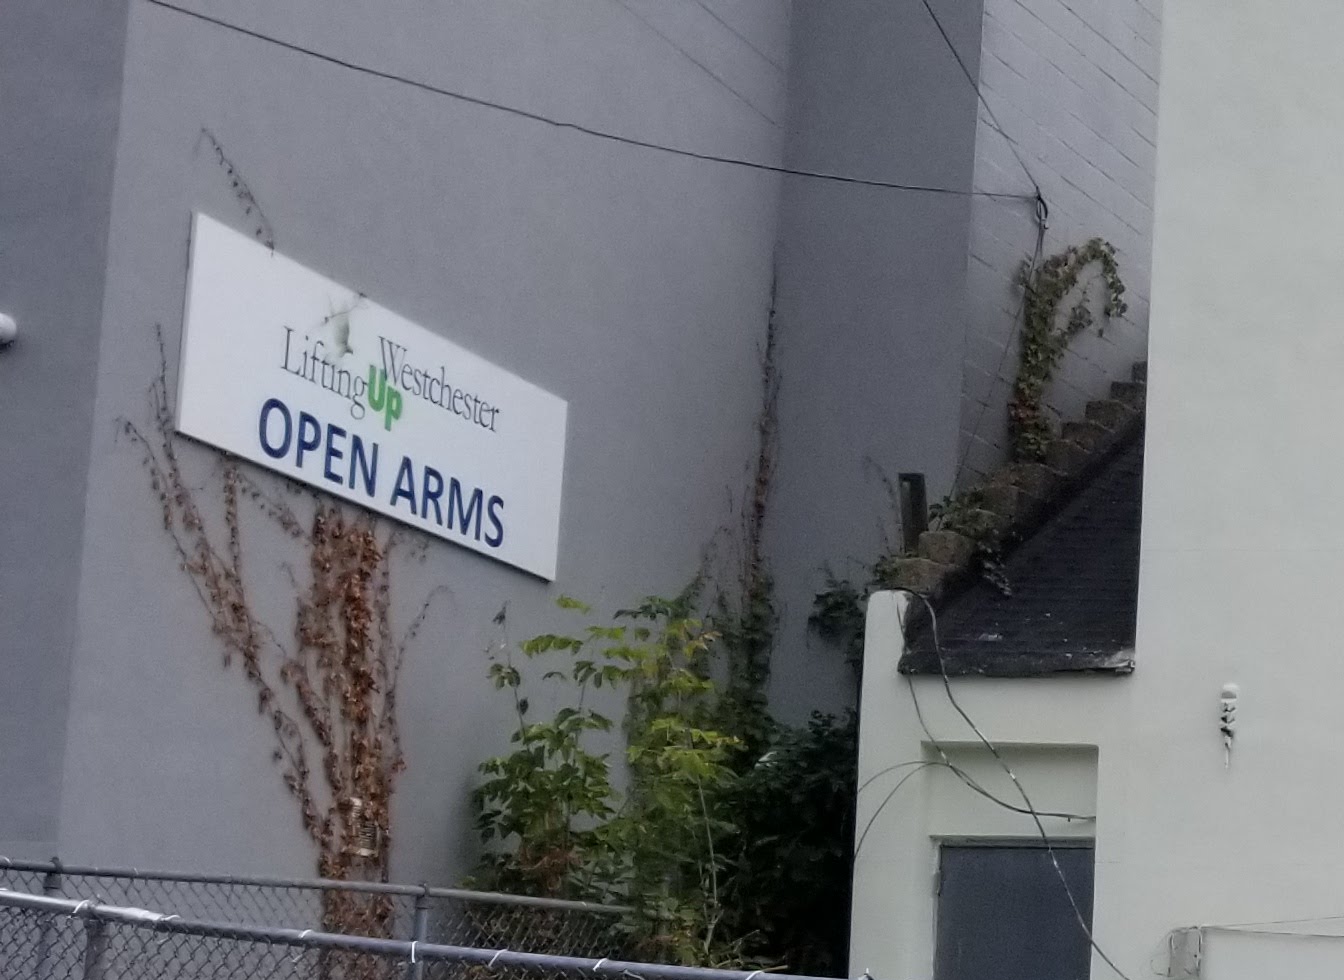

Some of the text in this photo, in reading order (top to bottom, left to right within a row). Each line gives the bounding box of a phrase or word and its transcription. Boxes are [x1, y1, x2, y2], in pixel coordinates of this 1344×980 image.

[280, 325, 368, 421] Lifting
[378, 335, 501, 433] Westchester
[258, 397, 505, 548] OPEN ARMS
